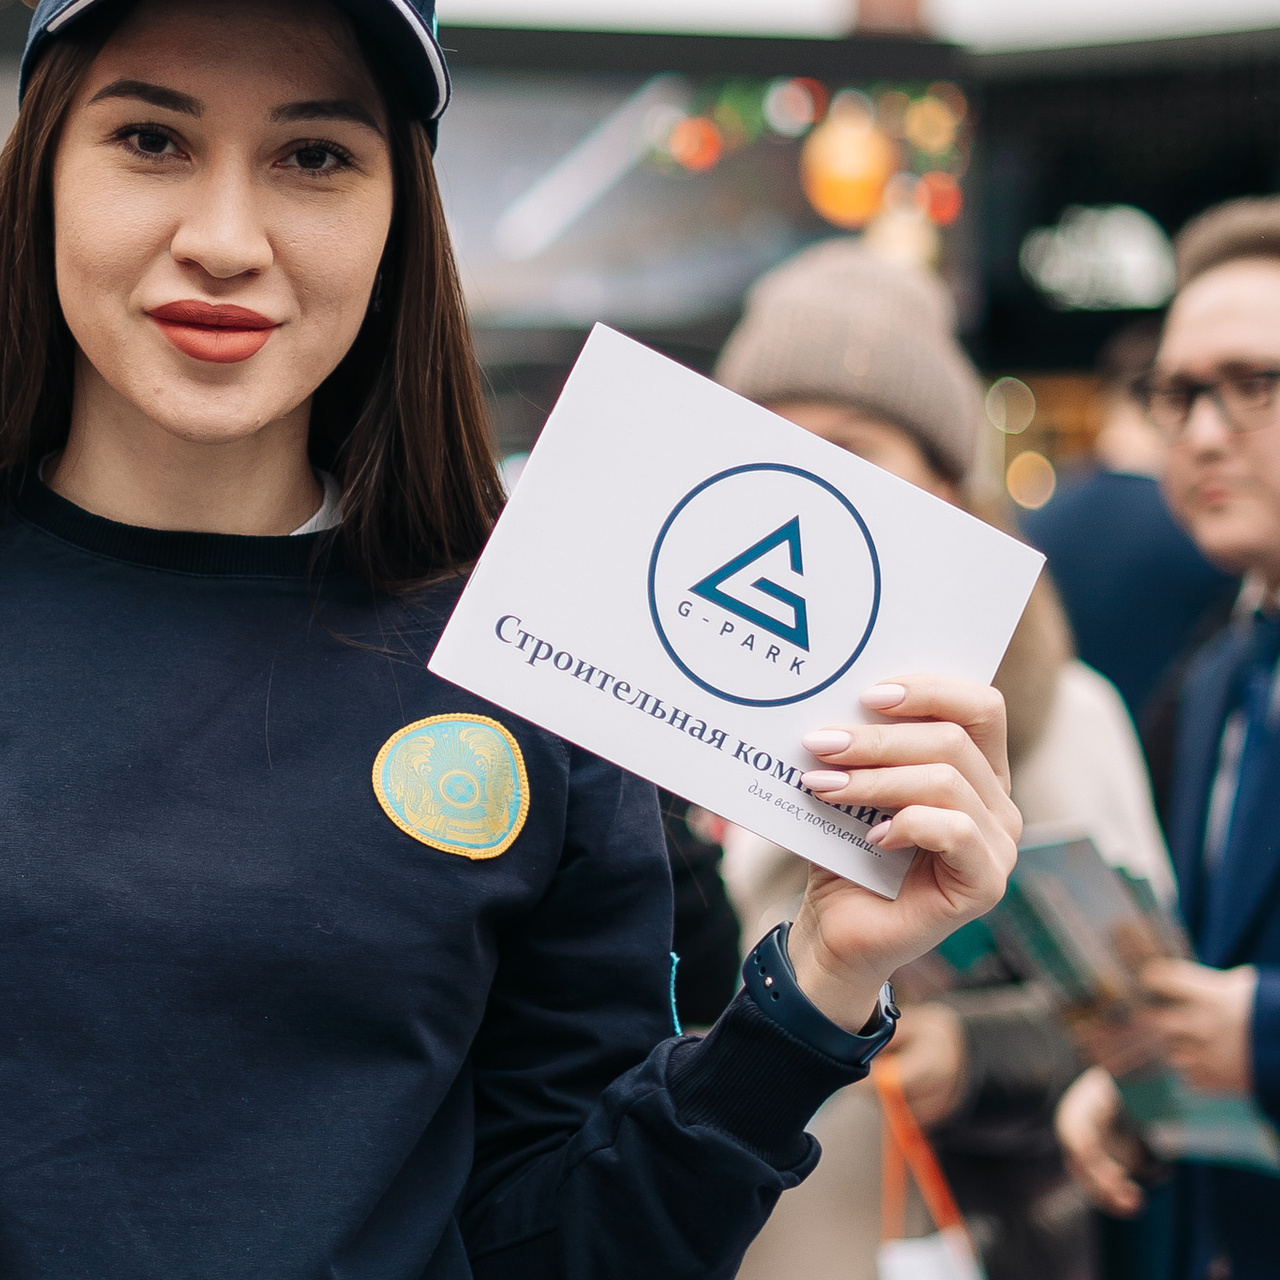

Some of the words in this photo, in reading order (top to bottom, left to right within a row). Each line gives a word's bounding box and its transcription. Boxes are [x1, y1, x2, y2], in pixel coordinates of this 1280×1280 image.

[677, 600, 806, 675] G-PARK
[494, 614, 730, 752] Строительная
[747, 778, 773, 802] для
[774, 797, 805, 821] всех
